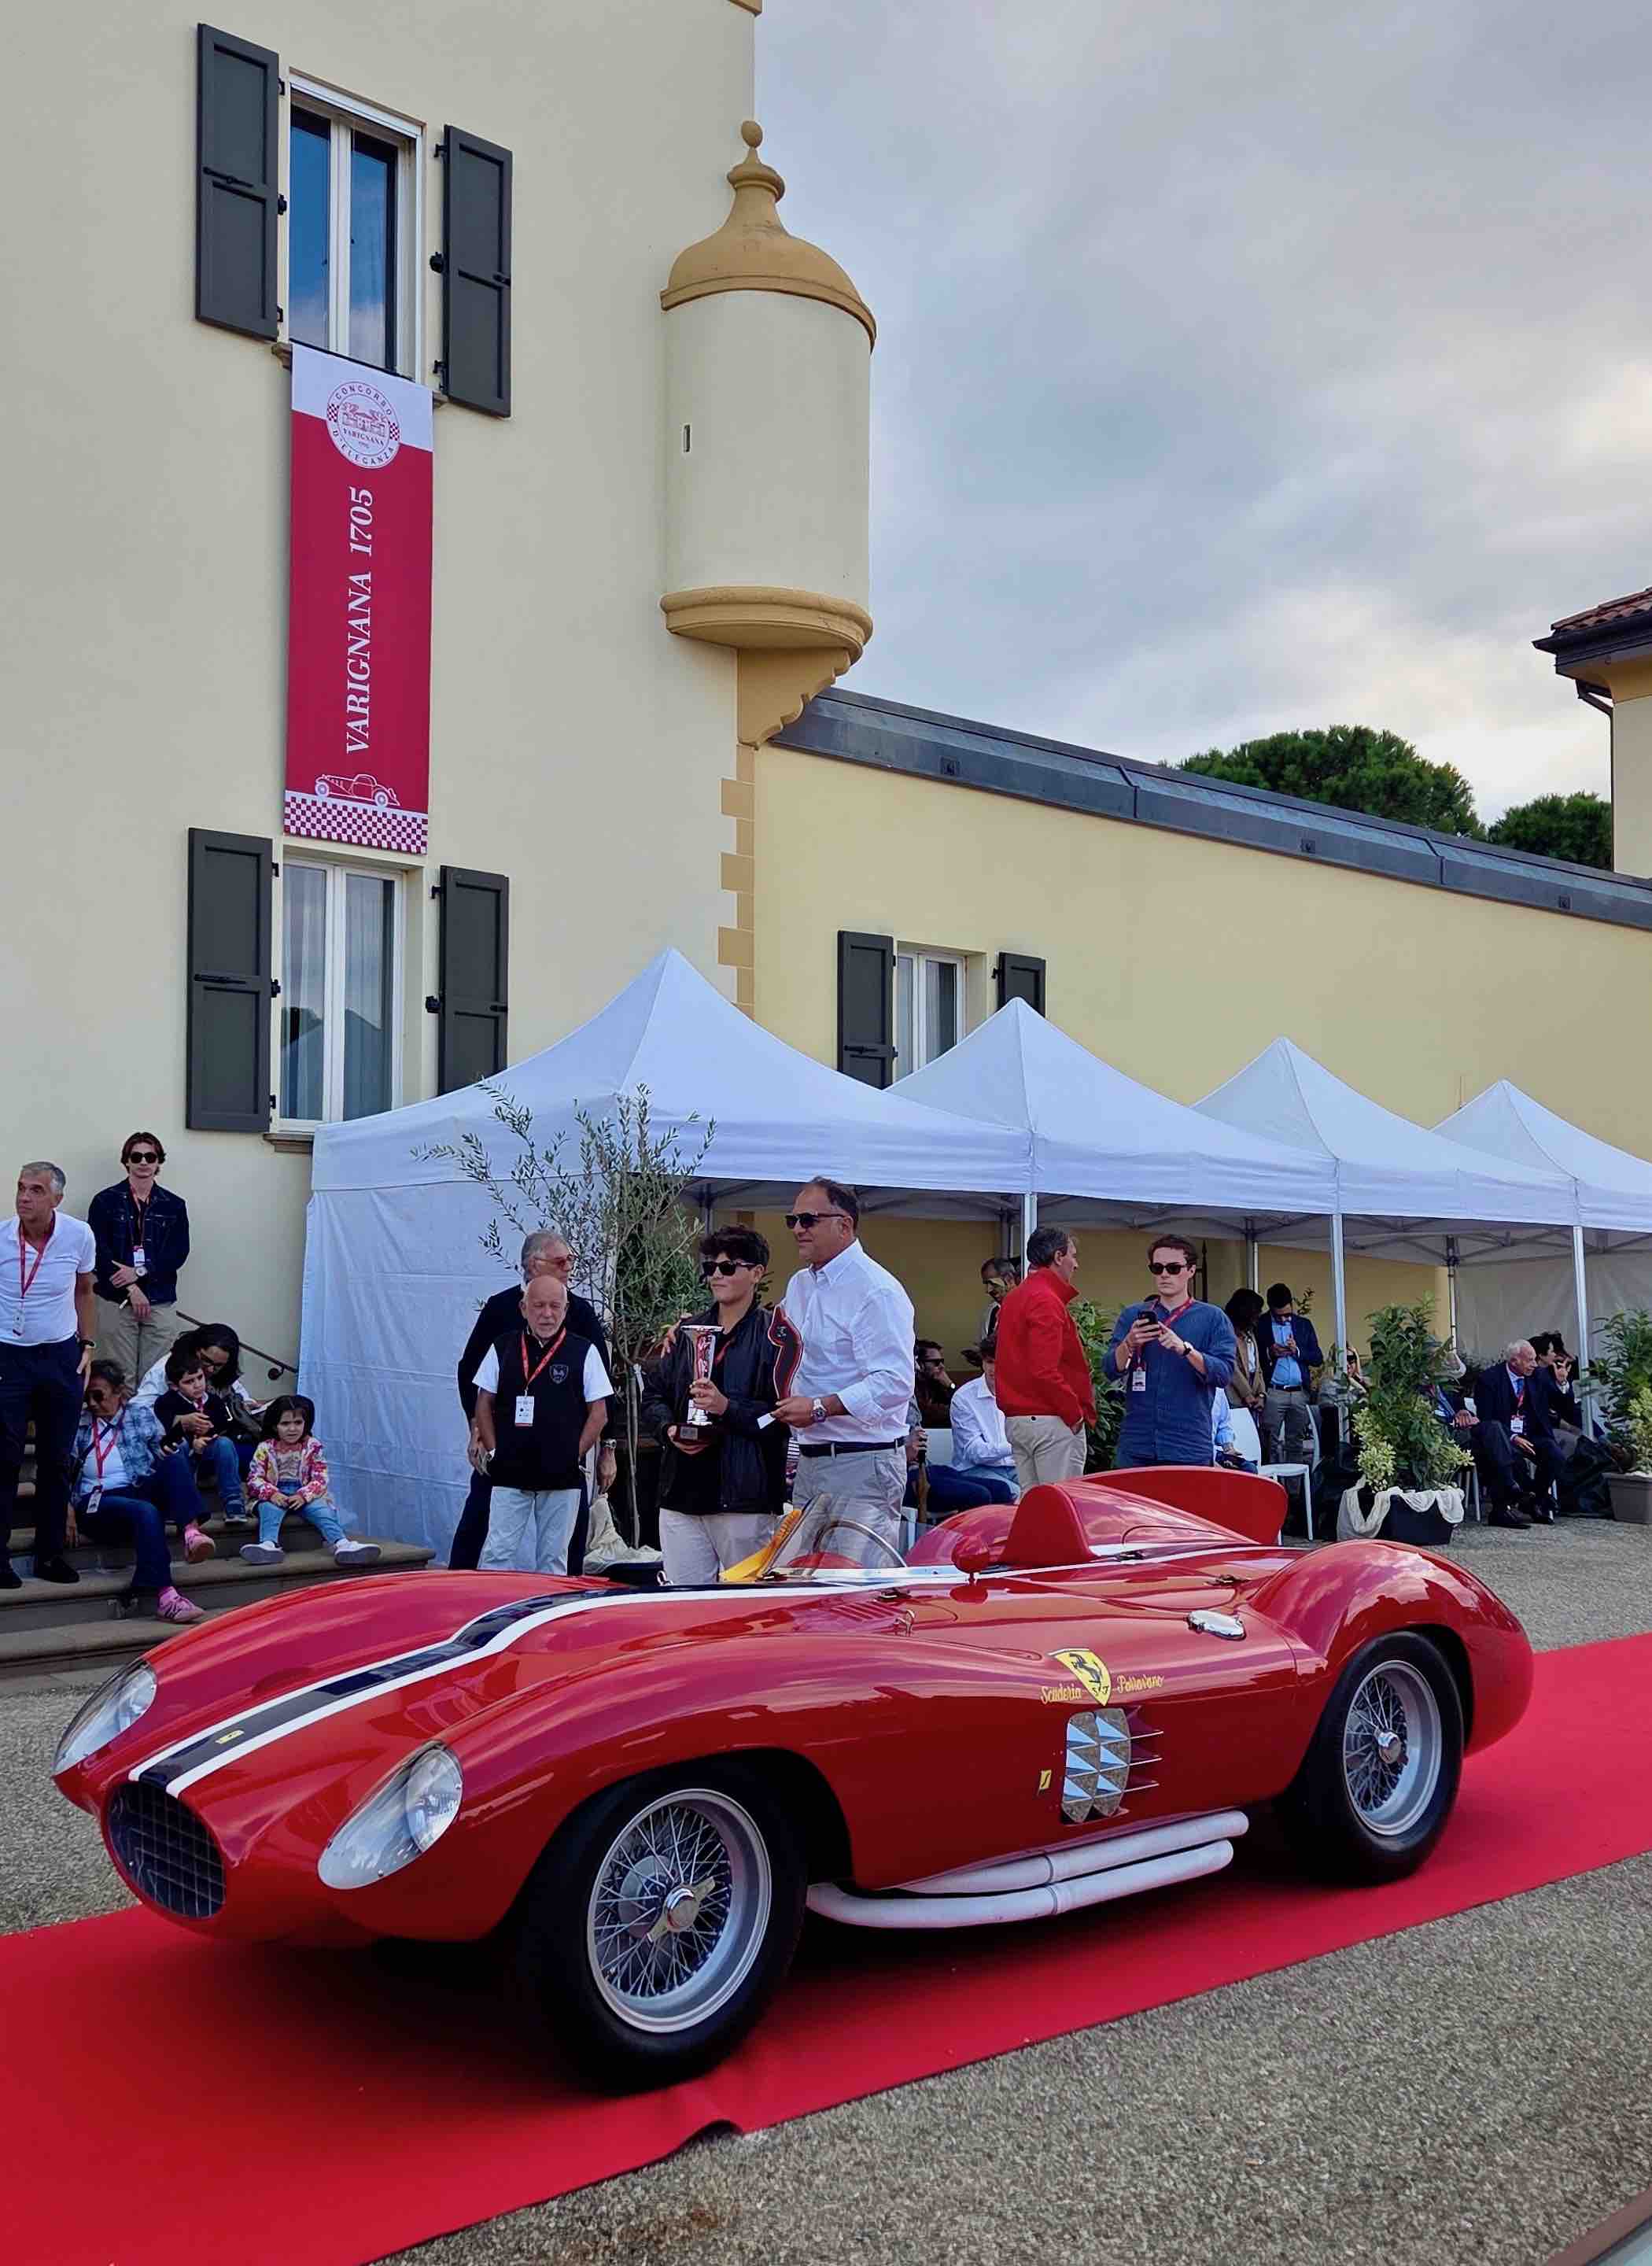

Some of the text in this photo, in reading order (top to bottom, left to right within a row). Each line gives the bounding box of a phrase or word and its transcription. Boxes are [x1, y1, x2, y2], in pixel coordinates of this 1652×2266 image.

[346, 486, 373, 754] VARIGNANA 1705
[1040, 1682, 1082, 1705] Scuderia
